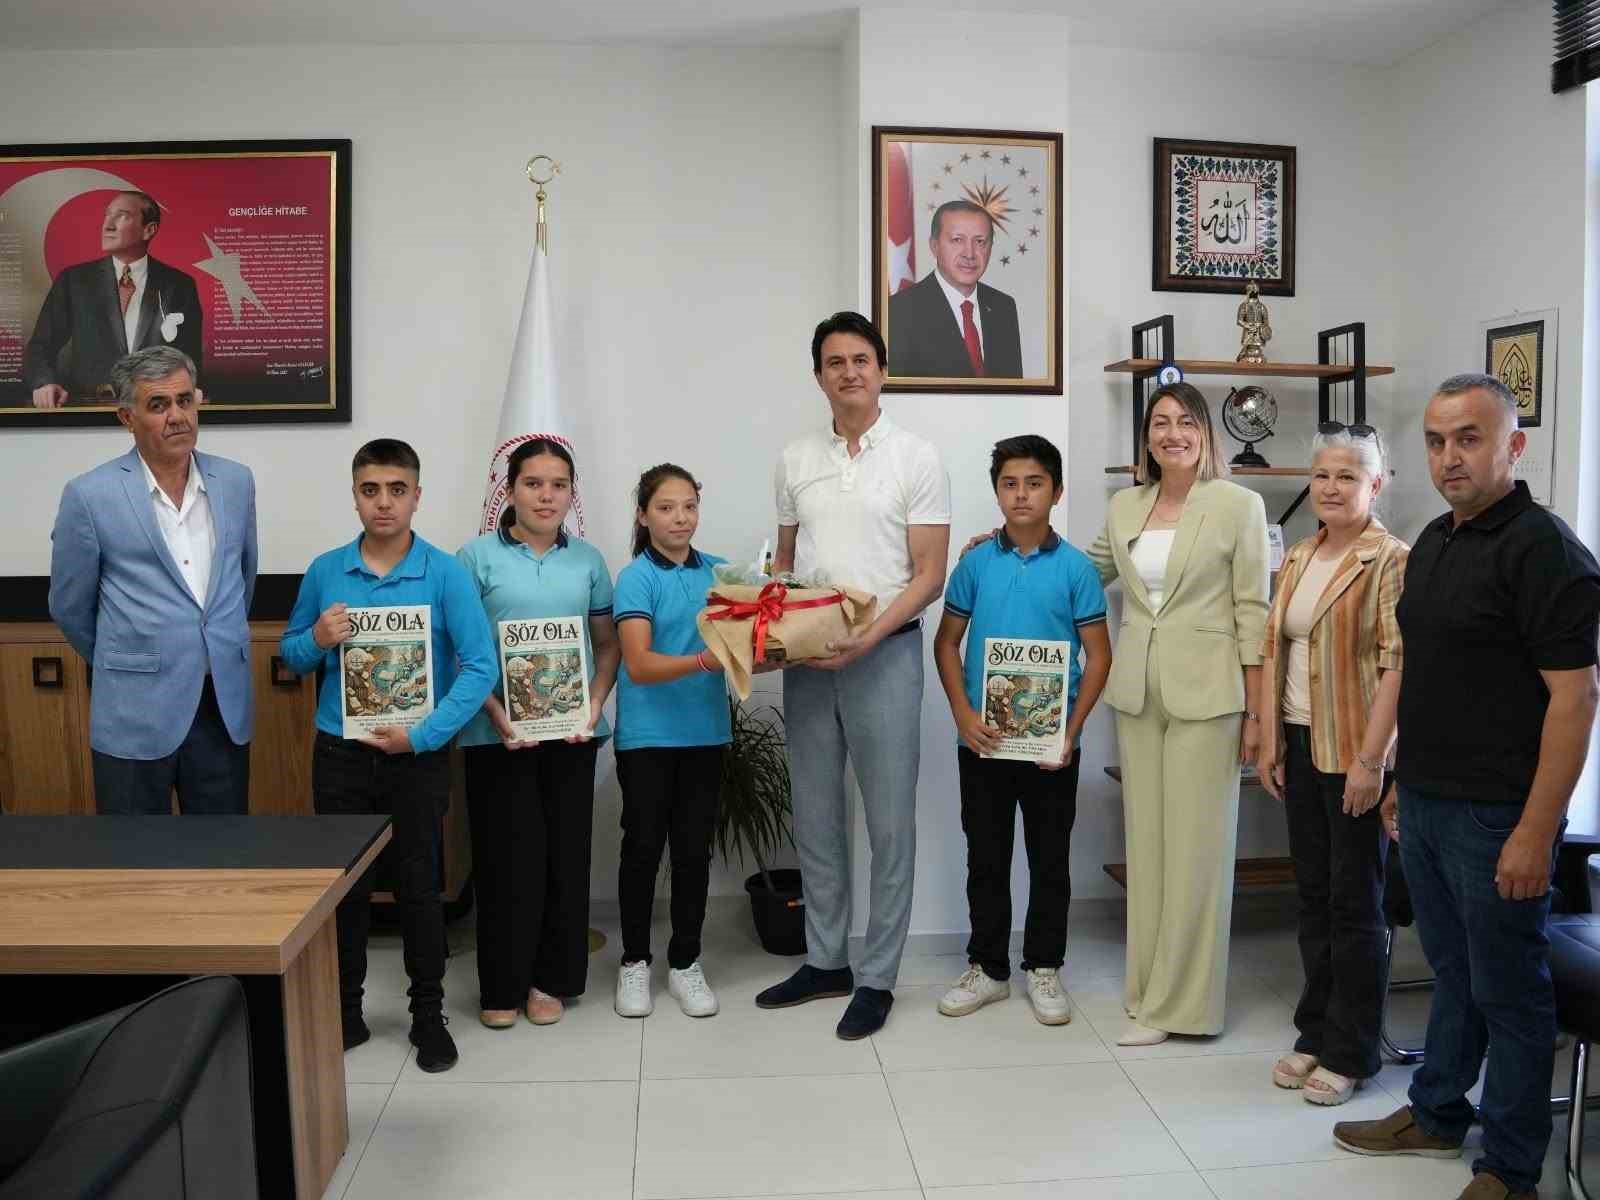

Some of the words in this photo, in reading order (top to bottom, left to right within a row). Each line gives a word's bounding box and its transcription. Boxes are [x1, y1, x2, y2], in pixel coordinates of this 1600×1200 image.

[275, 205, 308, 216] HİTABE
[348, 612, 381, 637] SÖZ
[386, 612, 424, 631] OLA
[504, 623, 539, 647] SÖZ
[543, 622, 578, 639] OLA
[989, 642, 1024, 665] SÖZ
[1028, 645, 1064, 664] OLA
